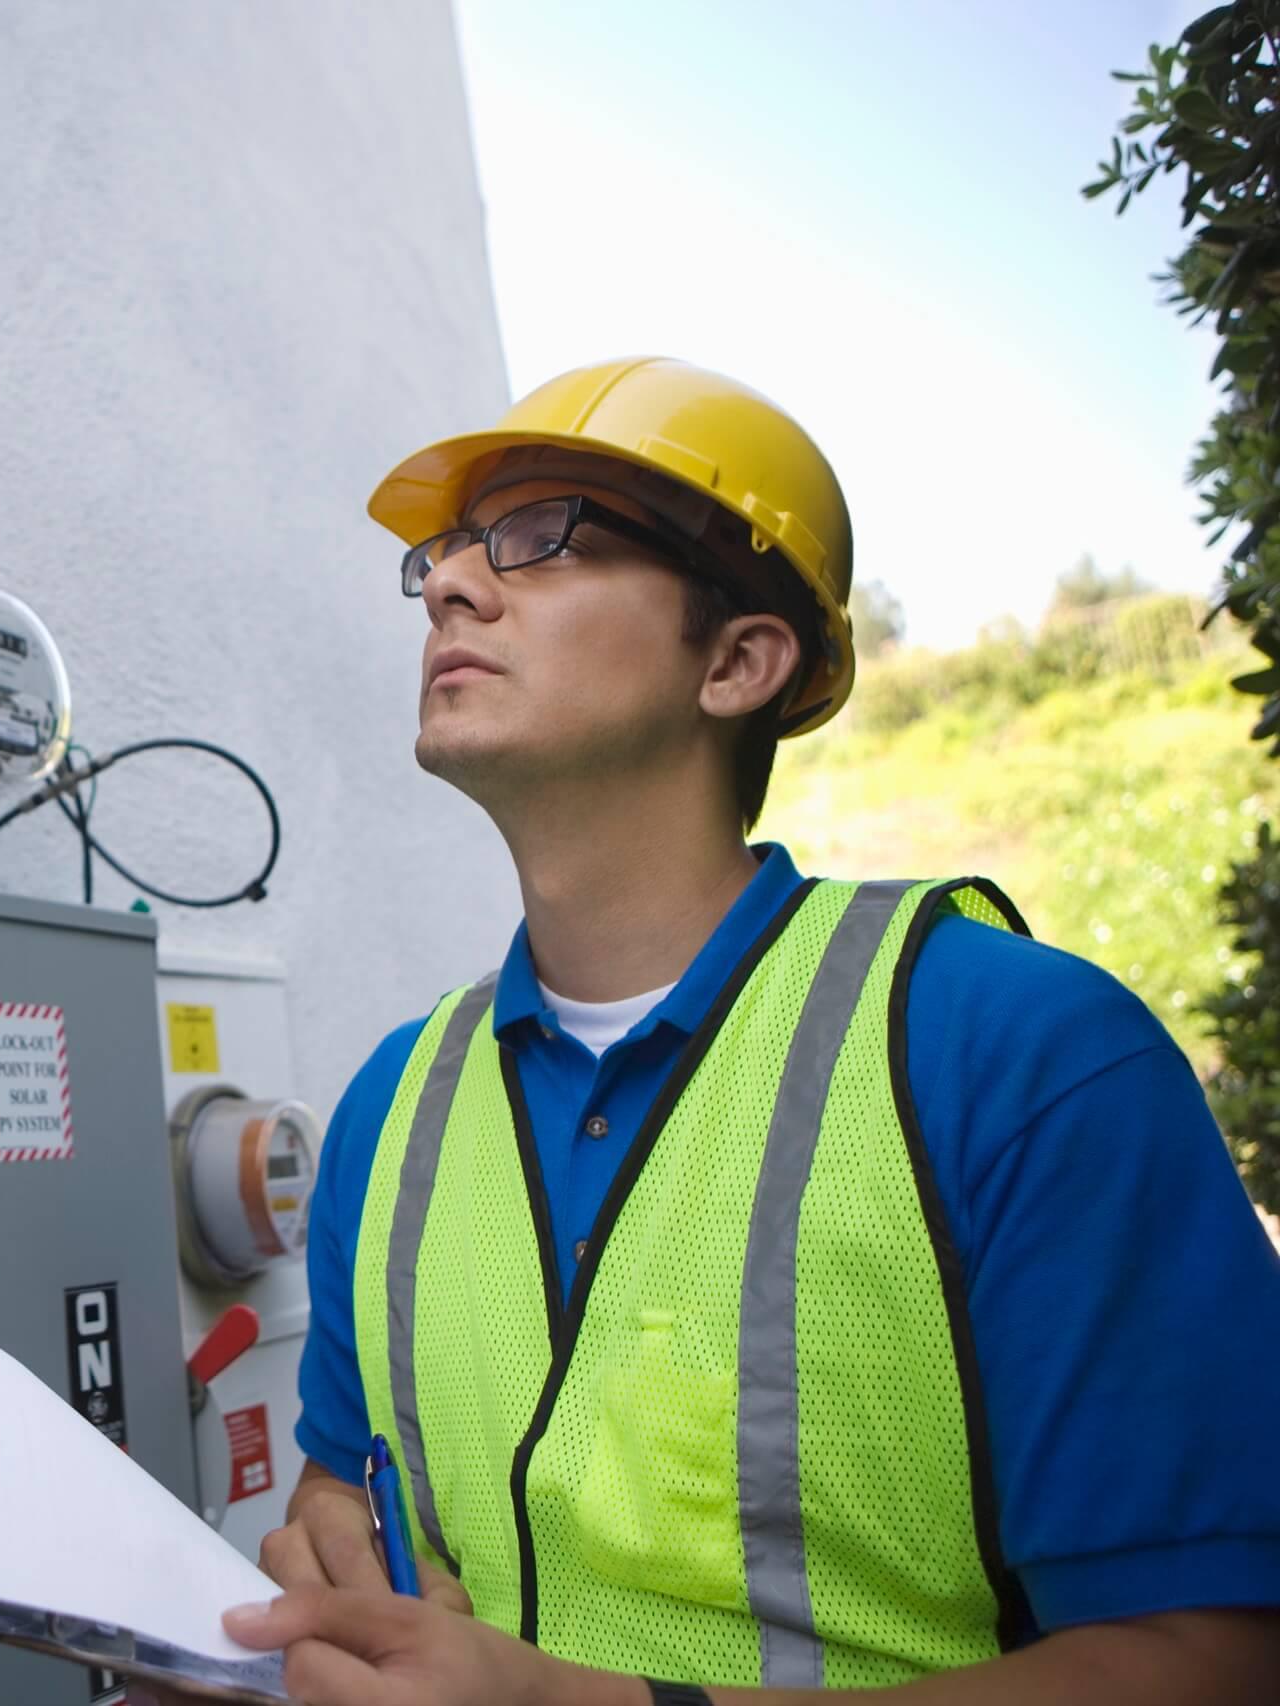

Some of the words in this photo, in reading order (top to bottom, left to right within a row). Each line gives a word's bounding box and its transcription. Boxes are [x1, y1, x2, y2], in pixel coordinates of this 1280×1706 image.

[35, 1062, 58, 1078] FOR
[9, 1089, 49, 1105] SOLAR
[0, 1116, 14, 1133] PV
[17, 1116, 62, 1132] SYSTEM
[75, 1290, 113, 1393] ON
